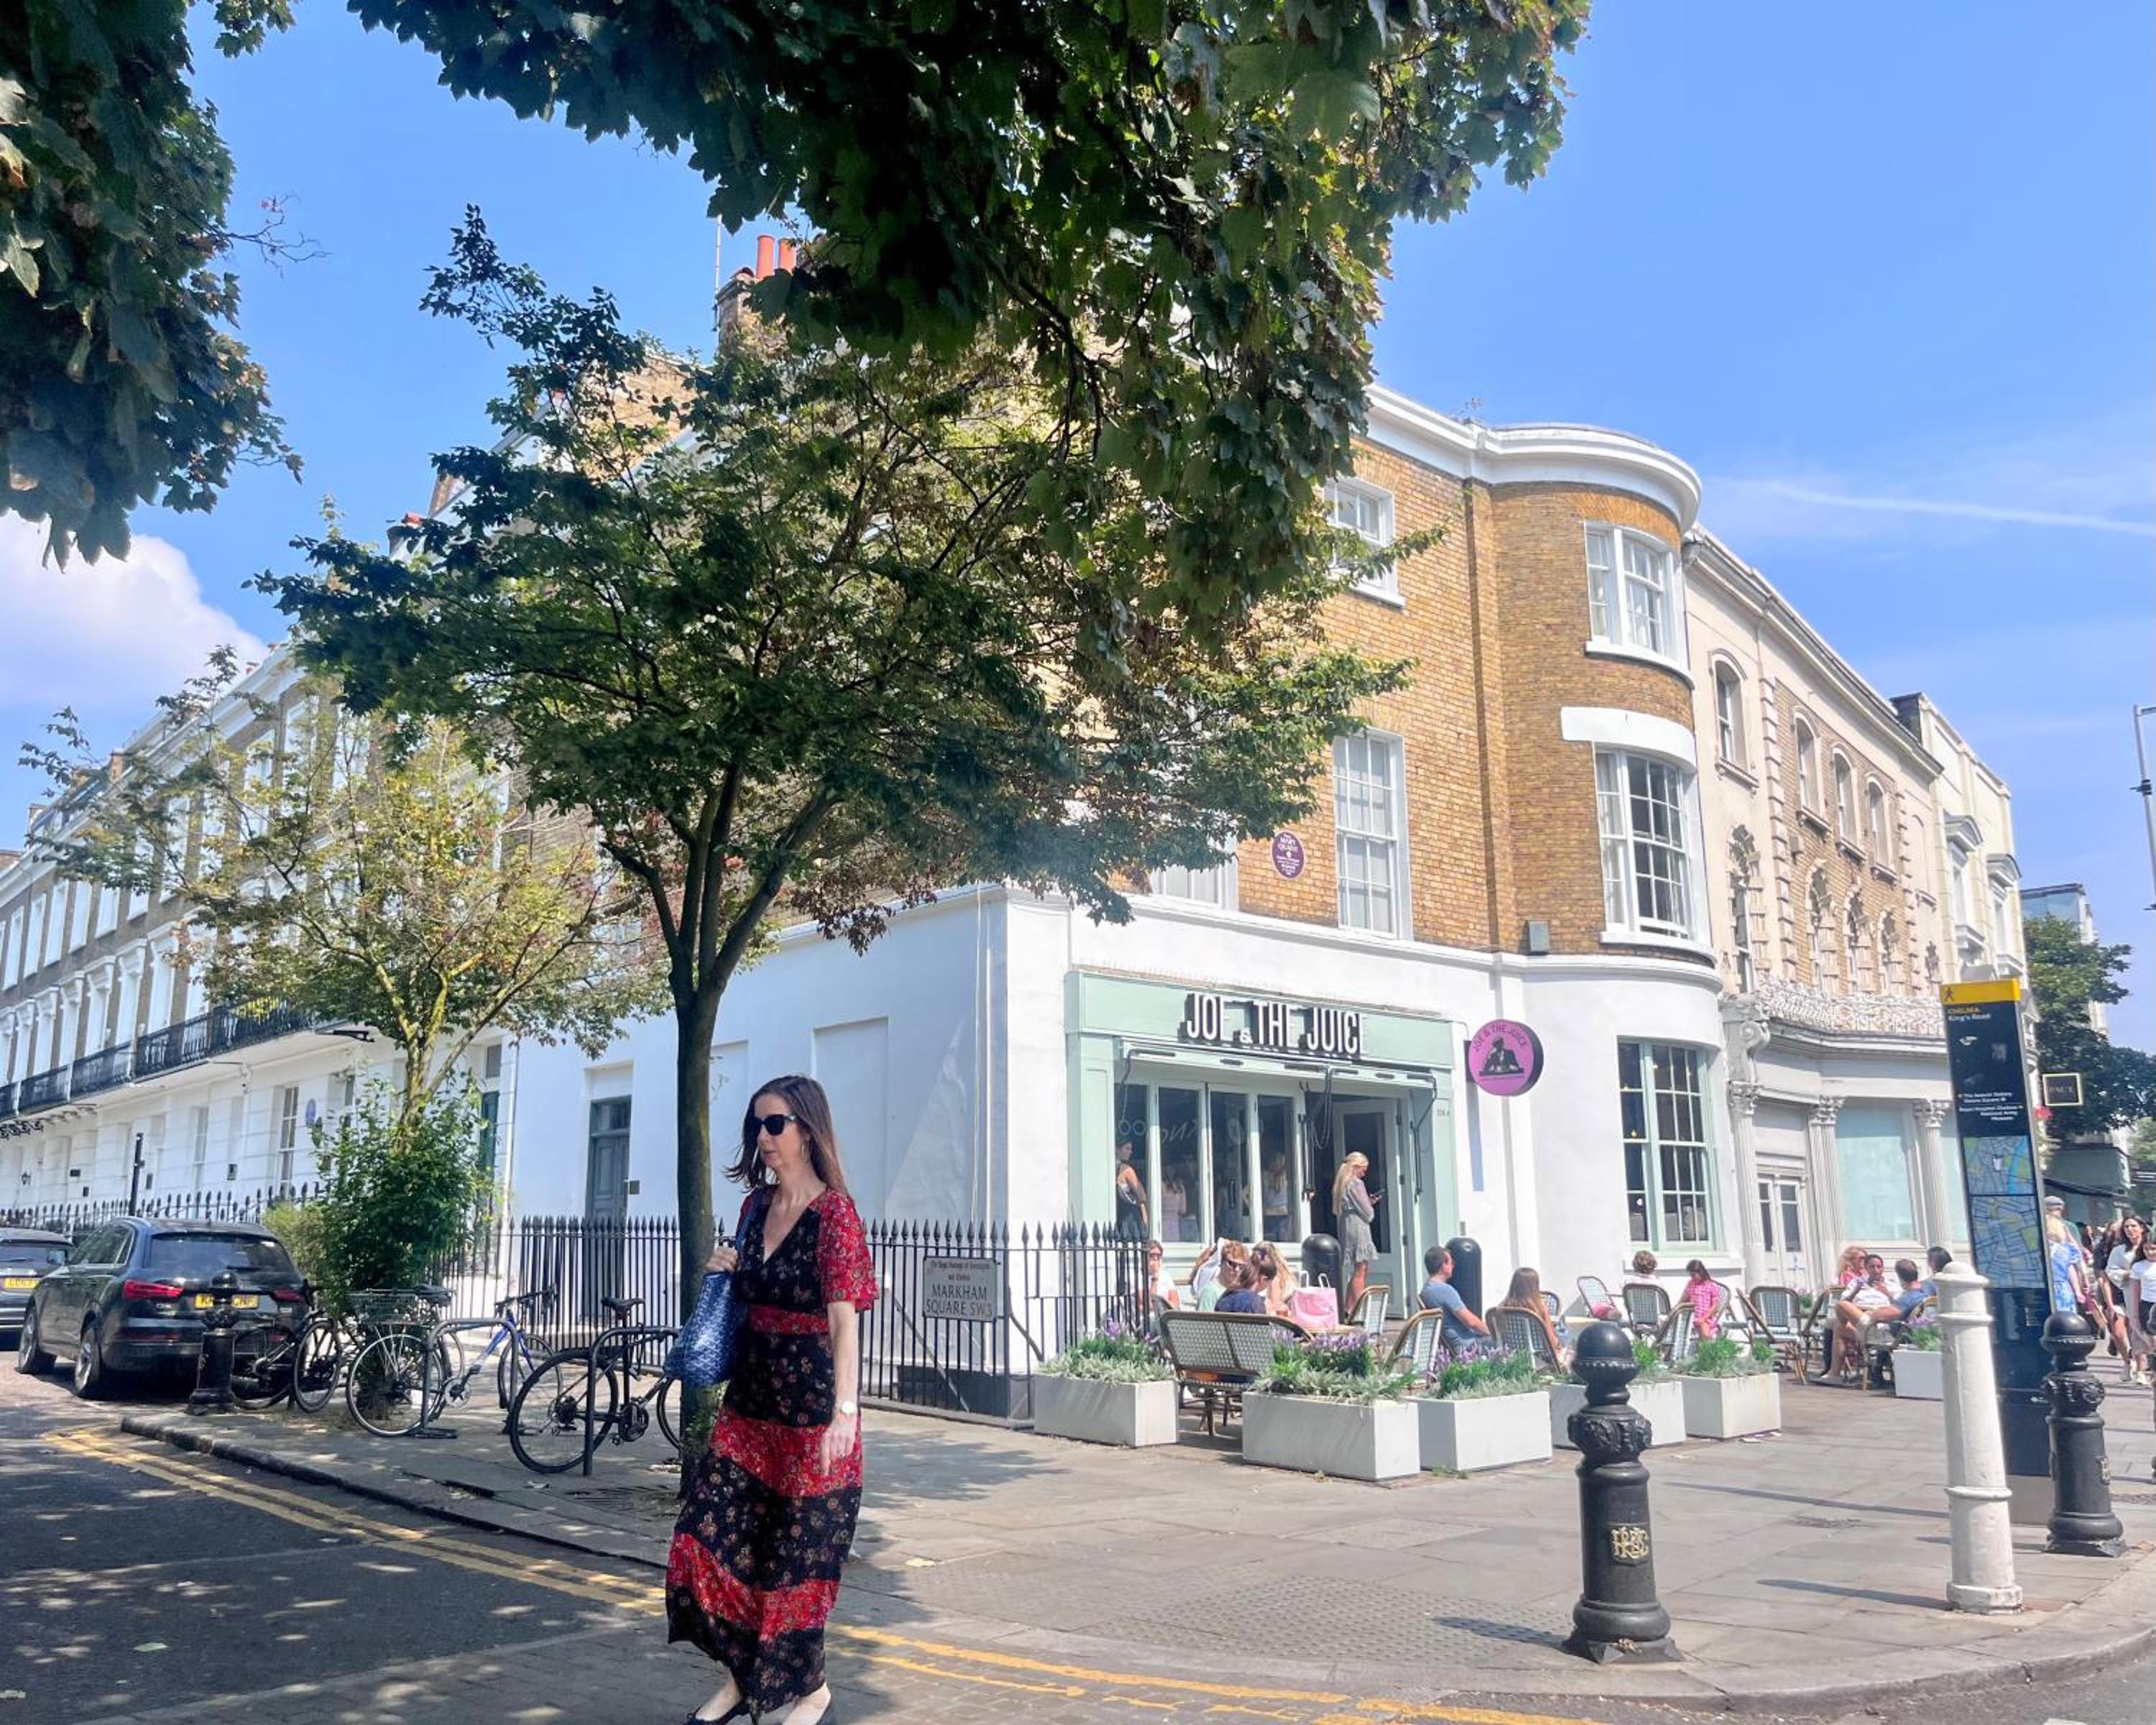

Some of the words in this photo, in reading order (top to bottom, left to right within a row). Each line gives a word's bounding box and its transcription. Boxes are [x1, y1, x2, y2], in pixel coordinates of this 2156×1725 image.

[1187, 992, 1234, 1041] JOE
[1239, 1028, 1253, 1044] &
[1253, 1000, 1300, 1048] THE
[1307, 1007, 1368, 1057] JUICE
[1492, 1024, 1508, 1033] THE
[931, 1284, 987, 1300] MARKHAM
[926, 1299, 967, 1315] SQUARE
[971, 1302, 992, 1318] SW3
